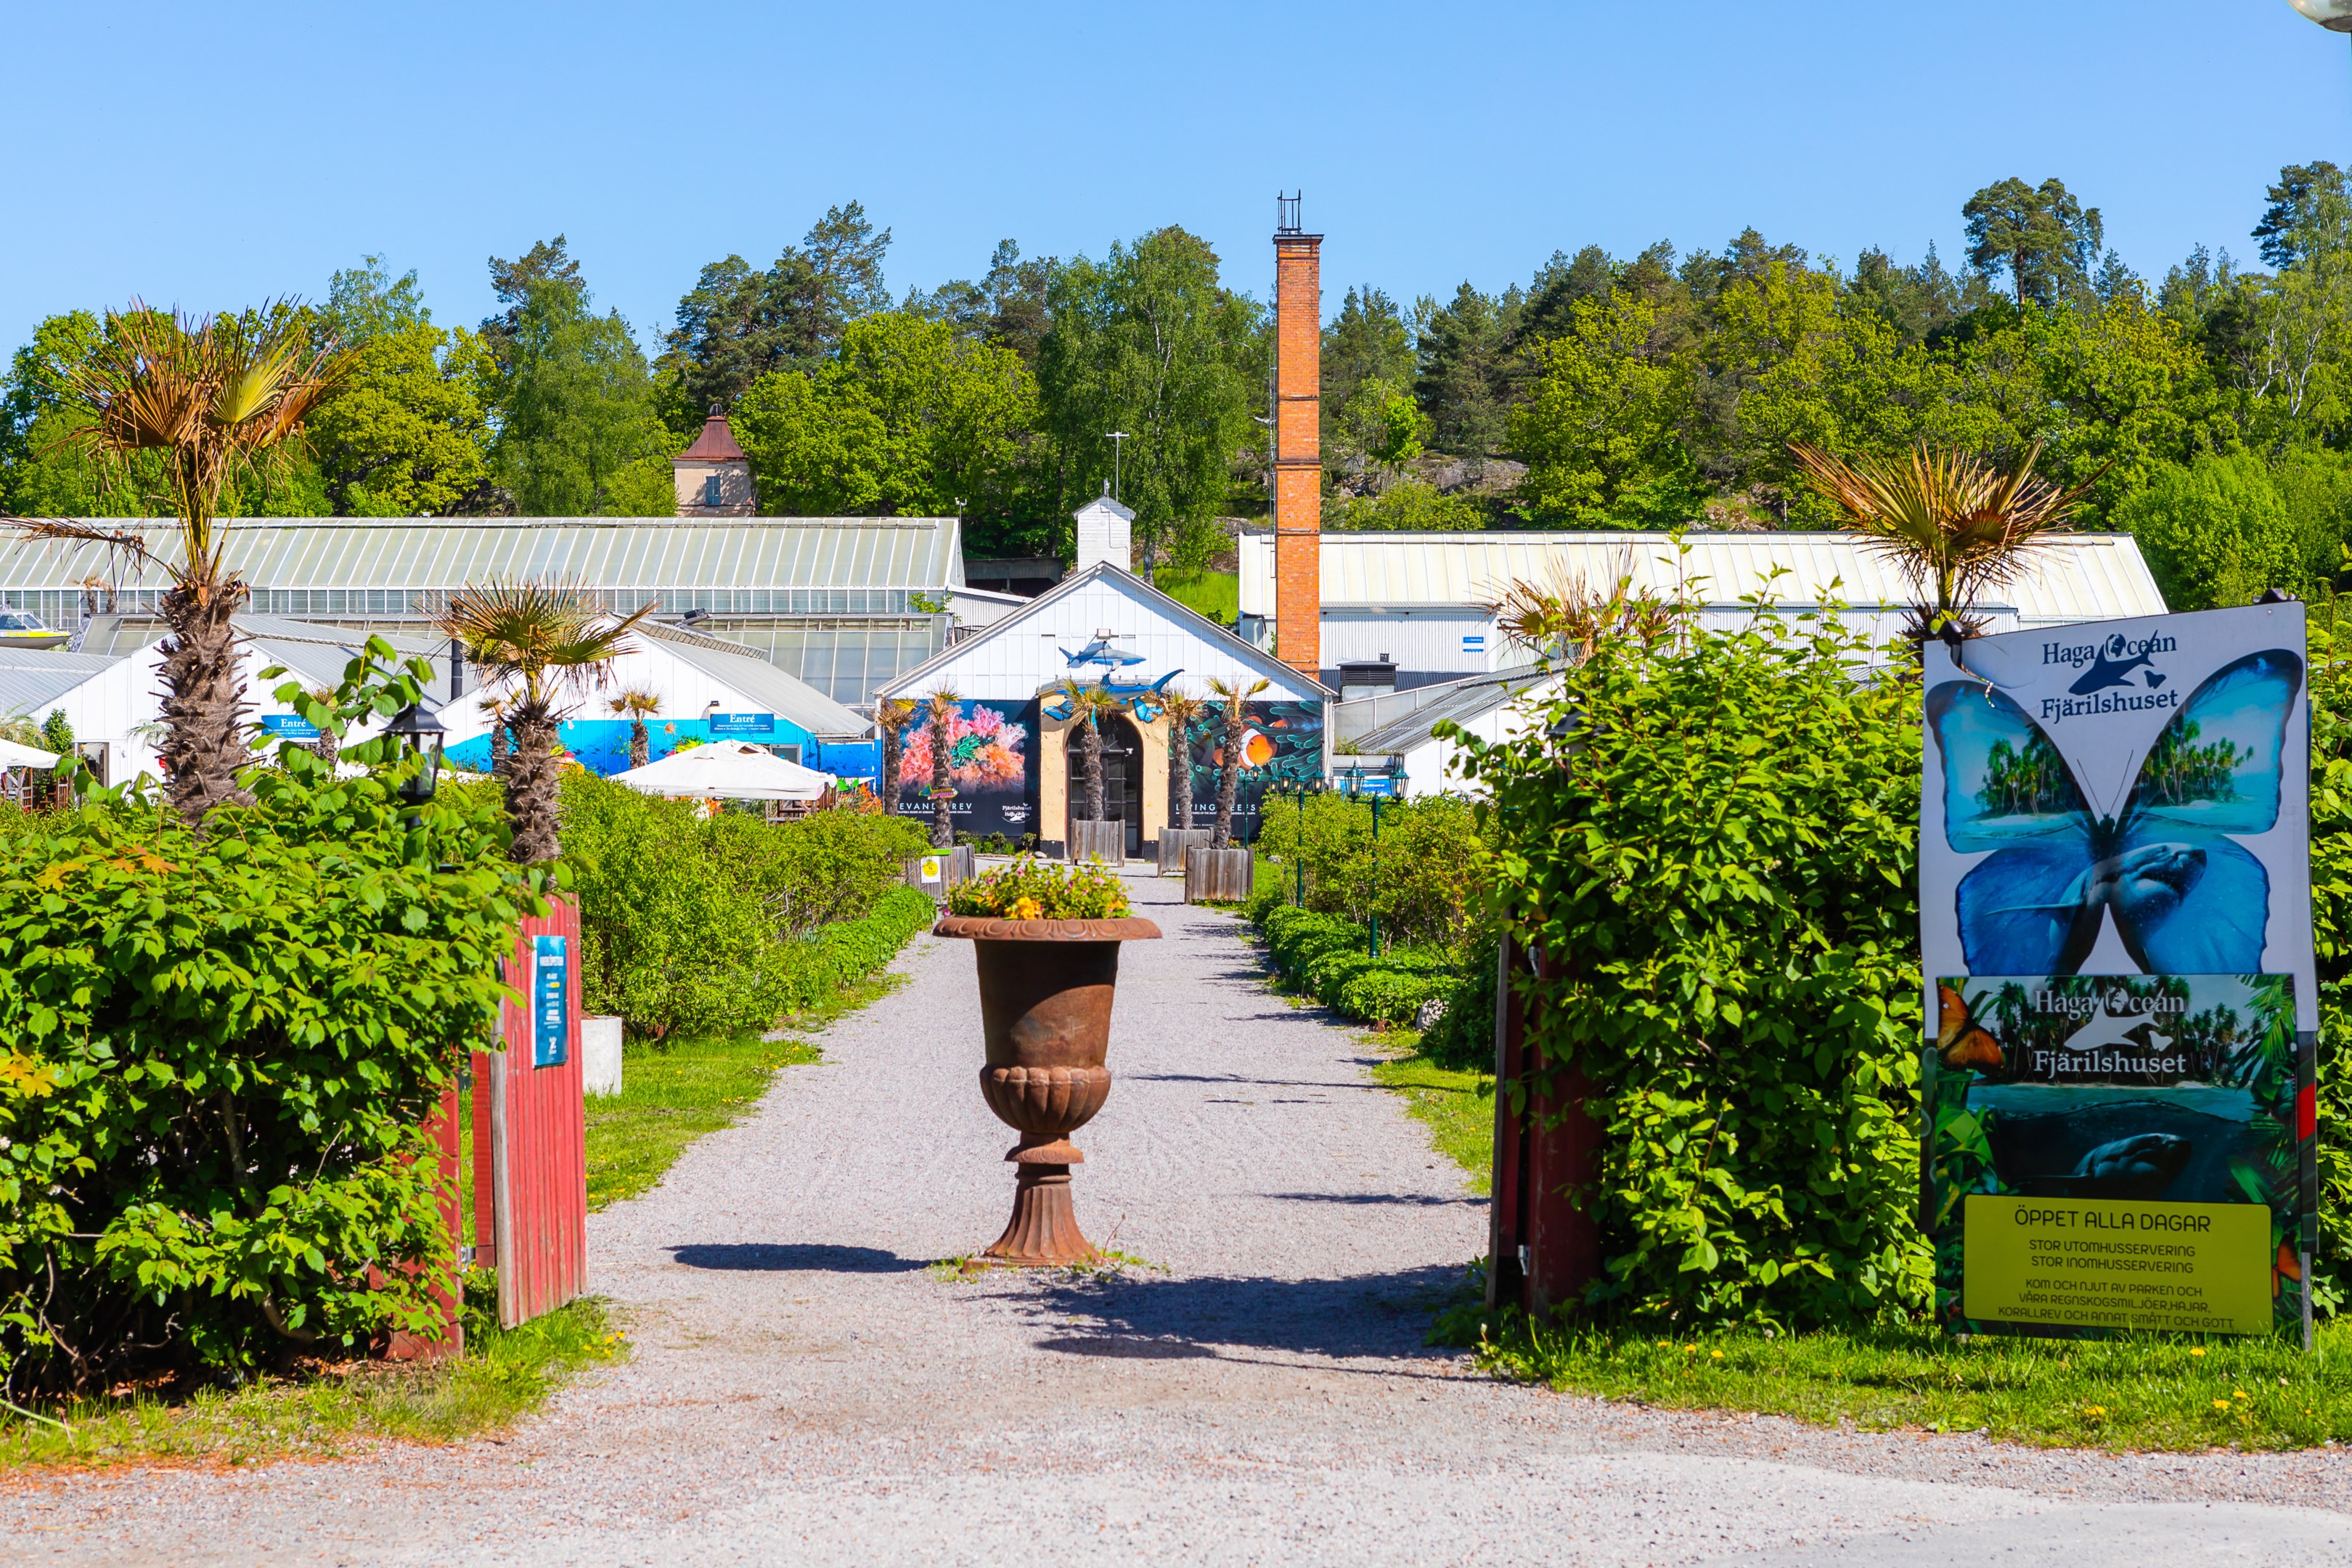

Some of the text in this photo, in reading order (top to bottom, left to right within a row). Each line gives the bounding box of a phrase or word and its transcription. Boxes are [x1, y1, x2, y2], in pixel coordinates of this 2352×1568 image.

[2042, 642, 2096, 669] Haga
[2041, 689, 2179, 724] Fjärilshuset
[281, 718, 306, 727] Entré
[730, 714, 755, 723] Entré
[2034, 989, 2094, 1021] Haga
[2034, 1050, 2186, 1079] Fjärilshuset
[2014, 1204, 2211, 1233] ÖPPET ALLA DAGAR
[2029, 1240, 2195, 1257] STOR UTOMHUSSERVERING
[2031, 1256, 2194, 1274] STOR INOMHUSSERVERING
[2019, 1291, 2048, 1304] VÅRA
[2026, 1279, 2202, 1297] KOM OCH NJUT AV PARKEN OCH
[1998, 1307, 2234, 1328] KORALLREV OCH ANNAT SMÅTT OCH GOTT
